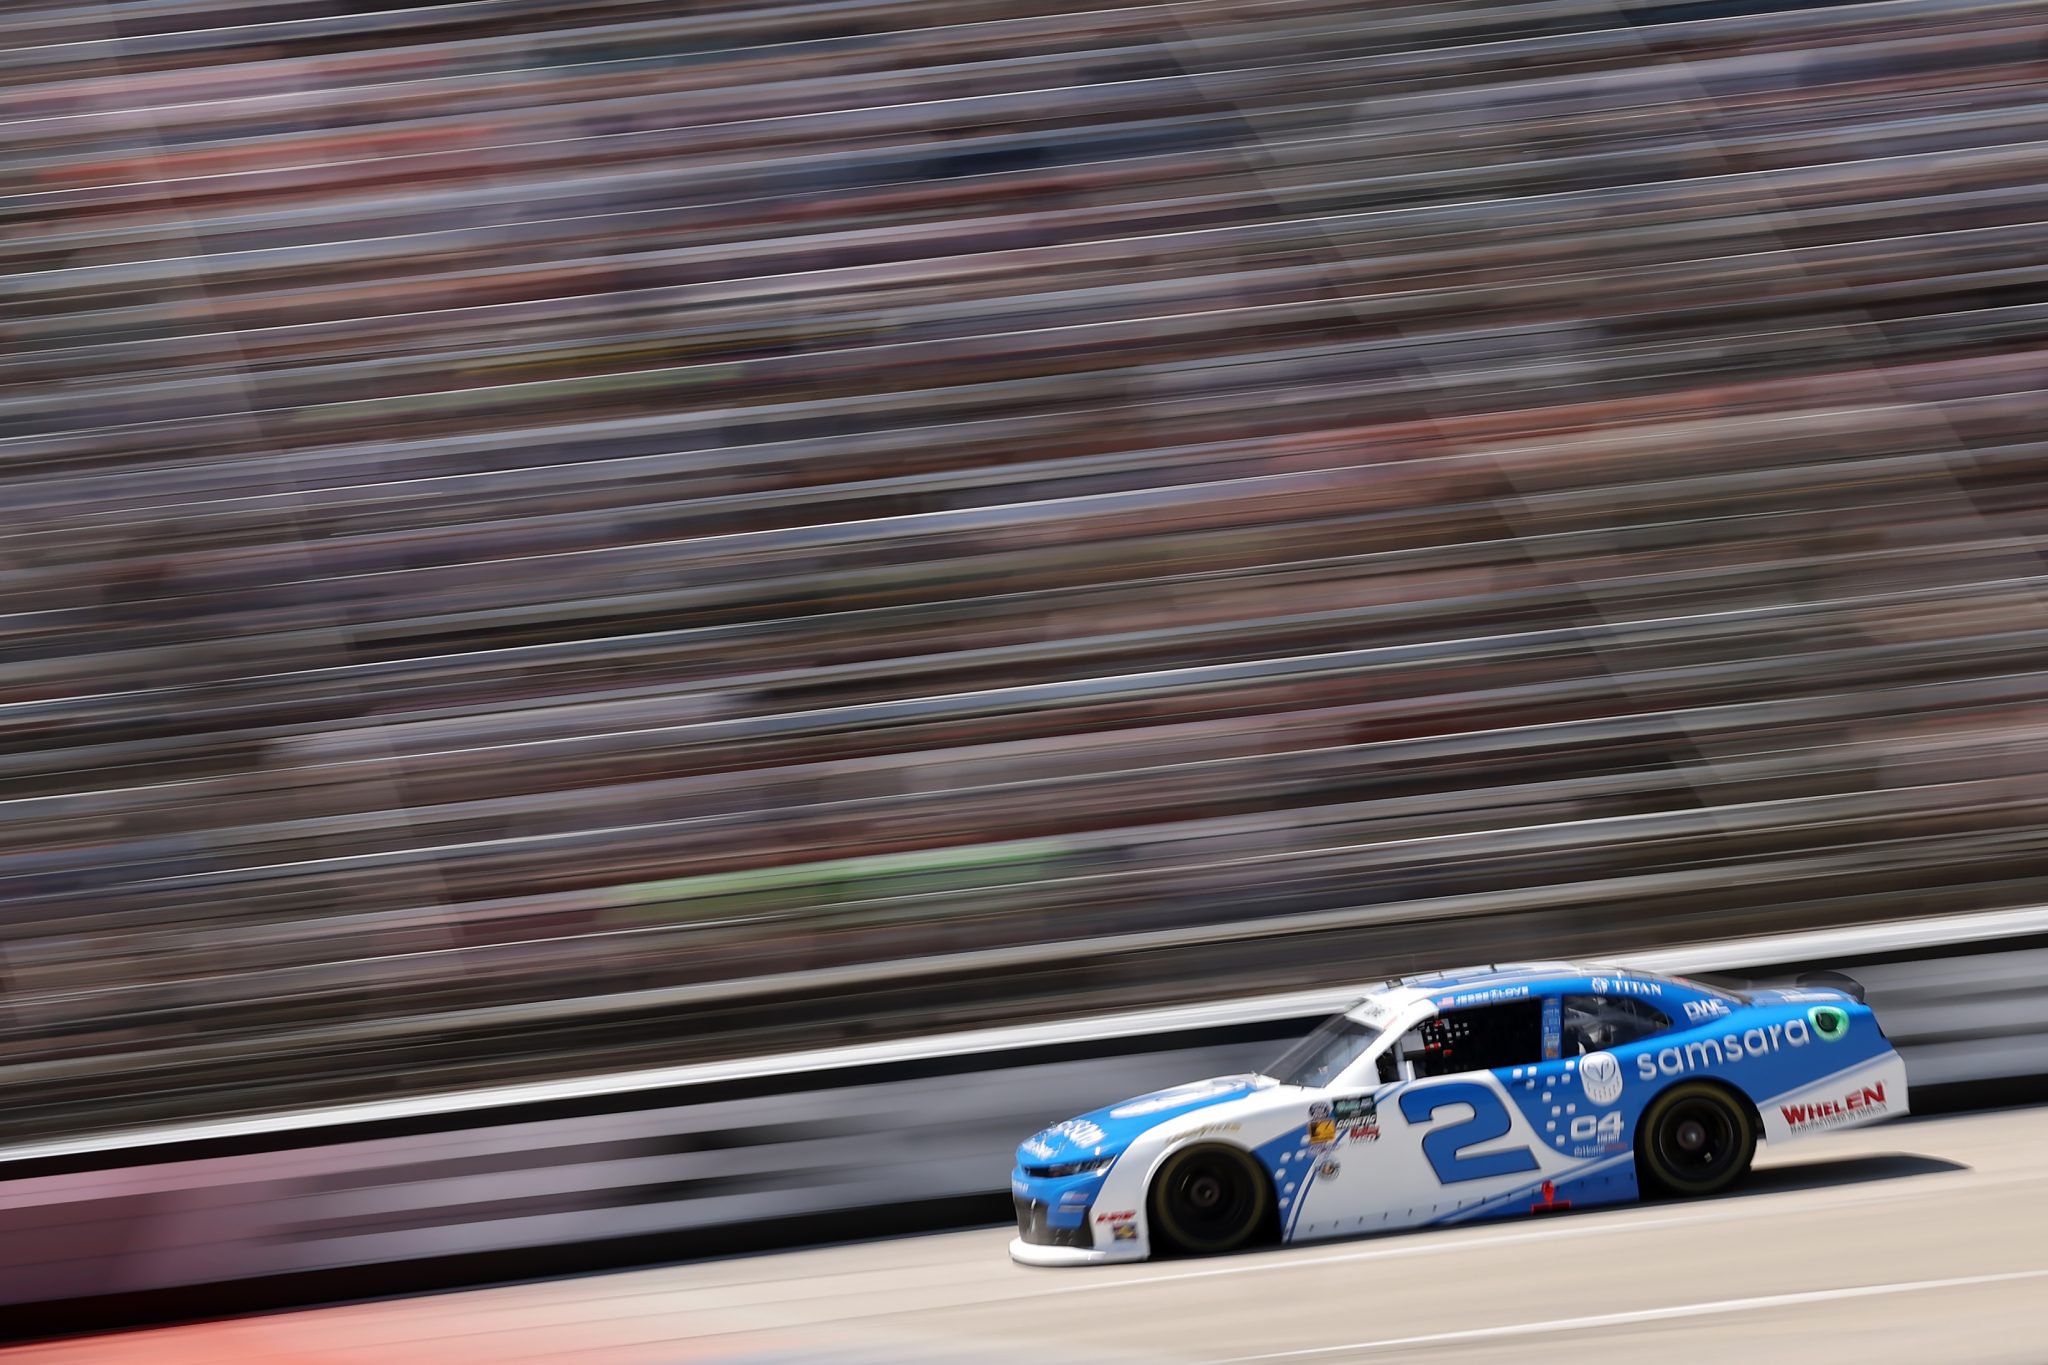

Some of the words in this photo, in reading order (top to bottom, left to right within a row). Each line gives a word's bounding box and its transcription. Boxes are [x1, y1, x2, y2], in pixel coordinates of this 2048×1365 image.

[1612, 979, 1662, 995] TITAN
[1636, 1018, 1810, 1081] samsara
[1780, 1080, 1886, 1125] WHELEN
[1398, 1081, 1541, 1184] 2
